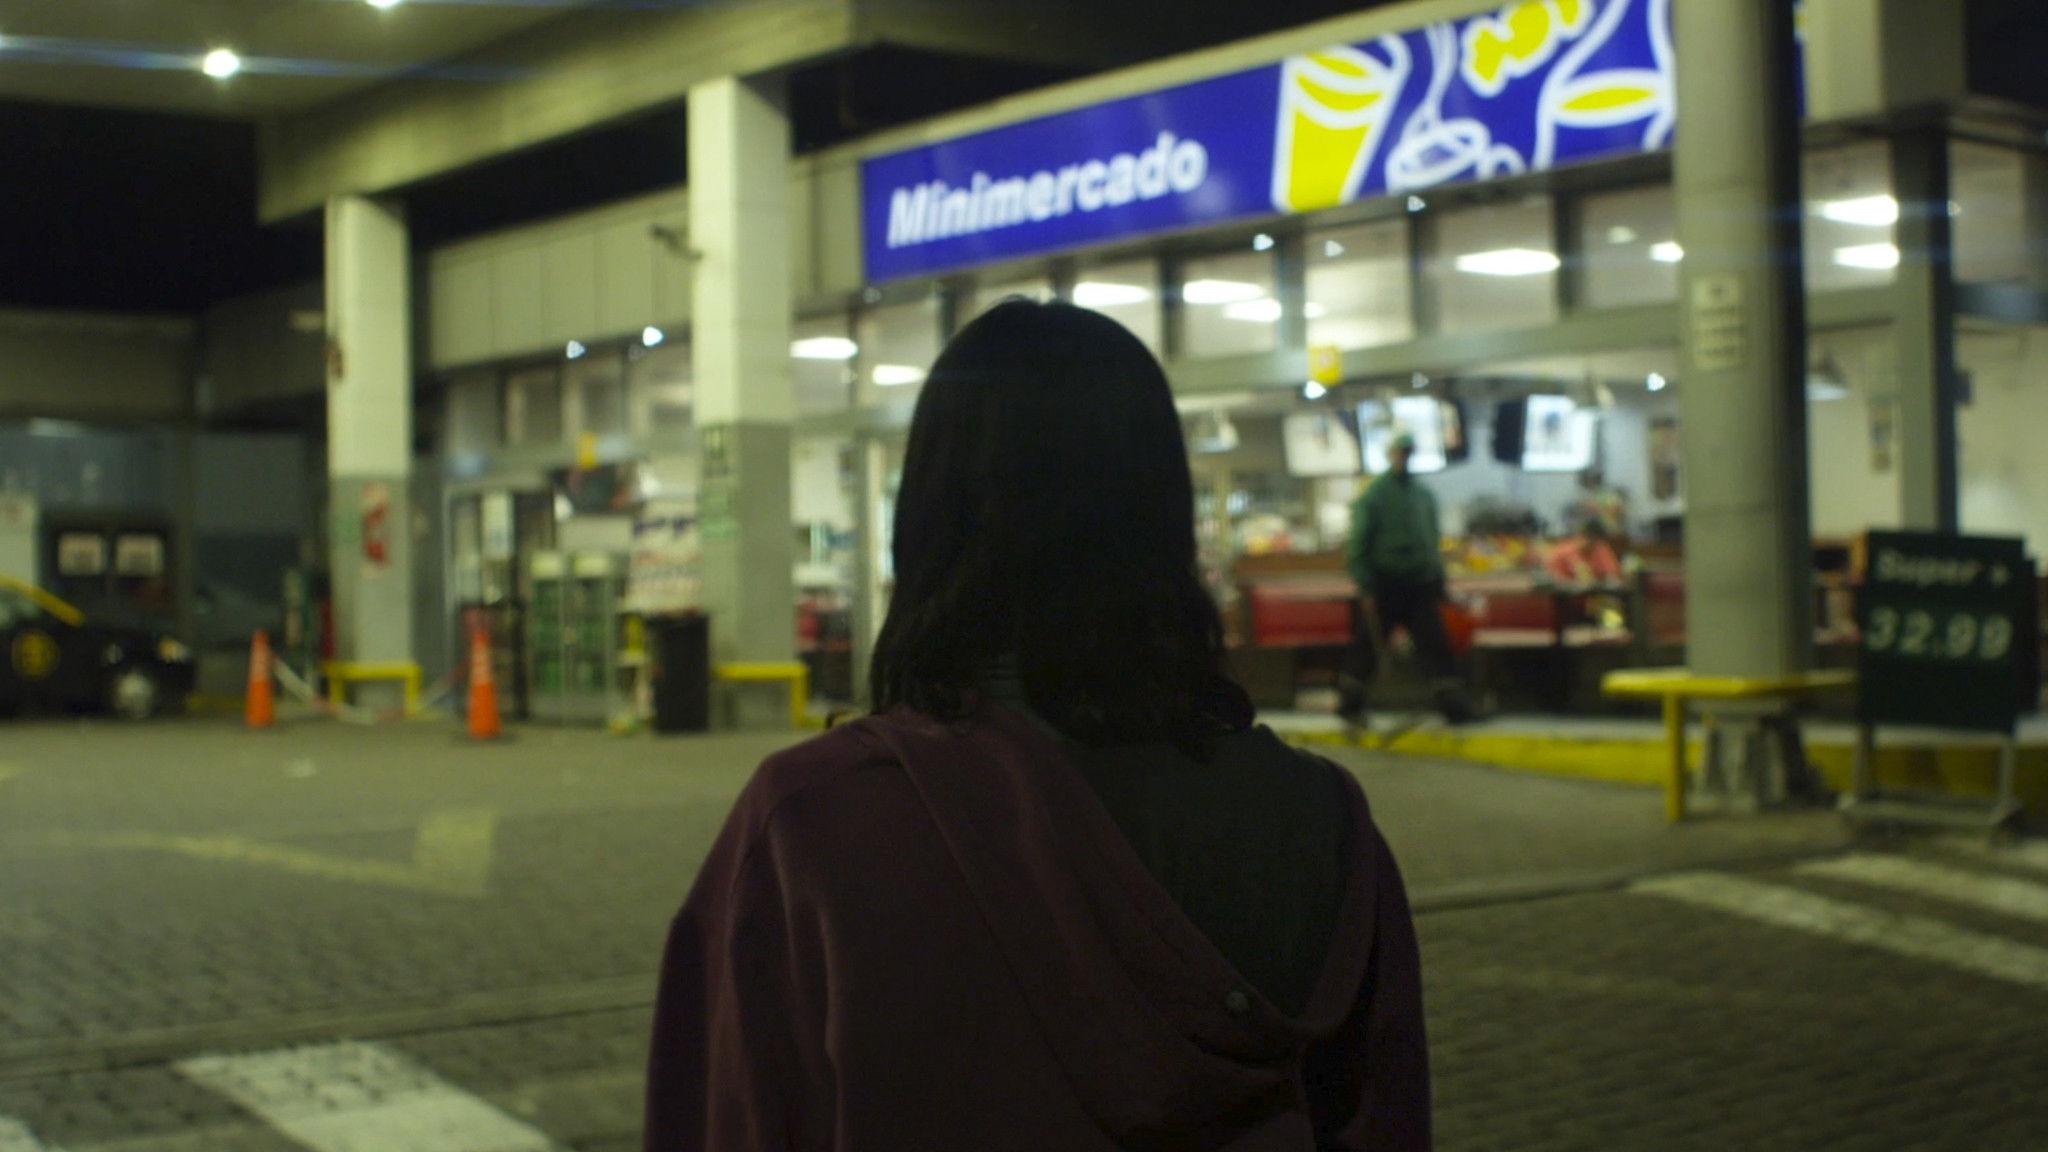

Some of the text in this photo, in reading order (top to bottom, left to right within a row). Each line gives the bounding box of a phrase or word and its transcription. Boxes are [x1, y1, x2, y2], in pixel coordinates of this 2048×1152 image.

[887, 131, 1207, 247] Minimercado
[1877, 549, 1982, 587] Super
[1867, 607, 2012, 659] 32.99
